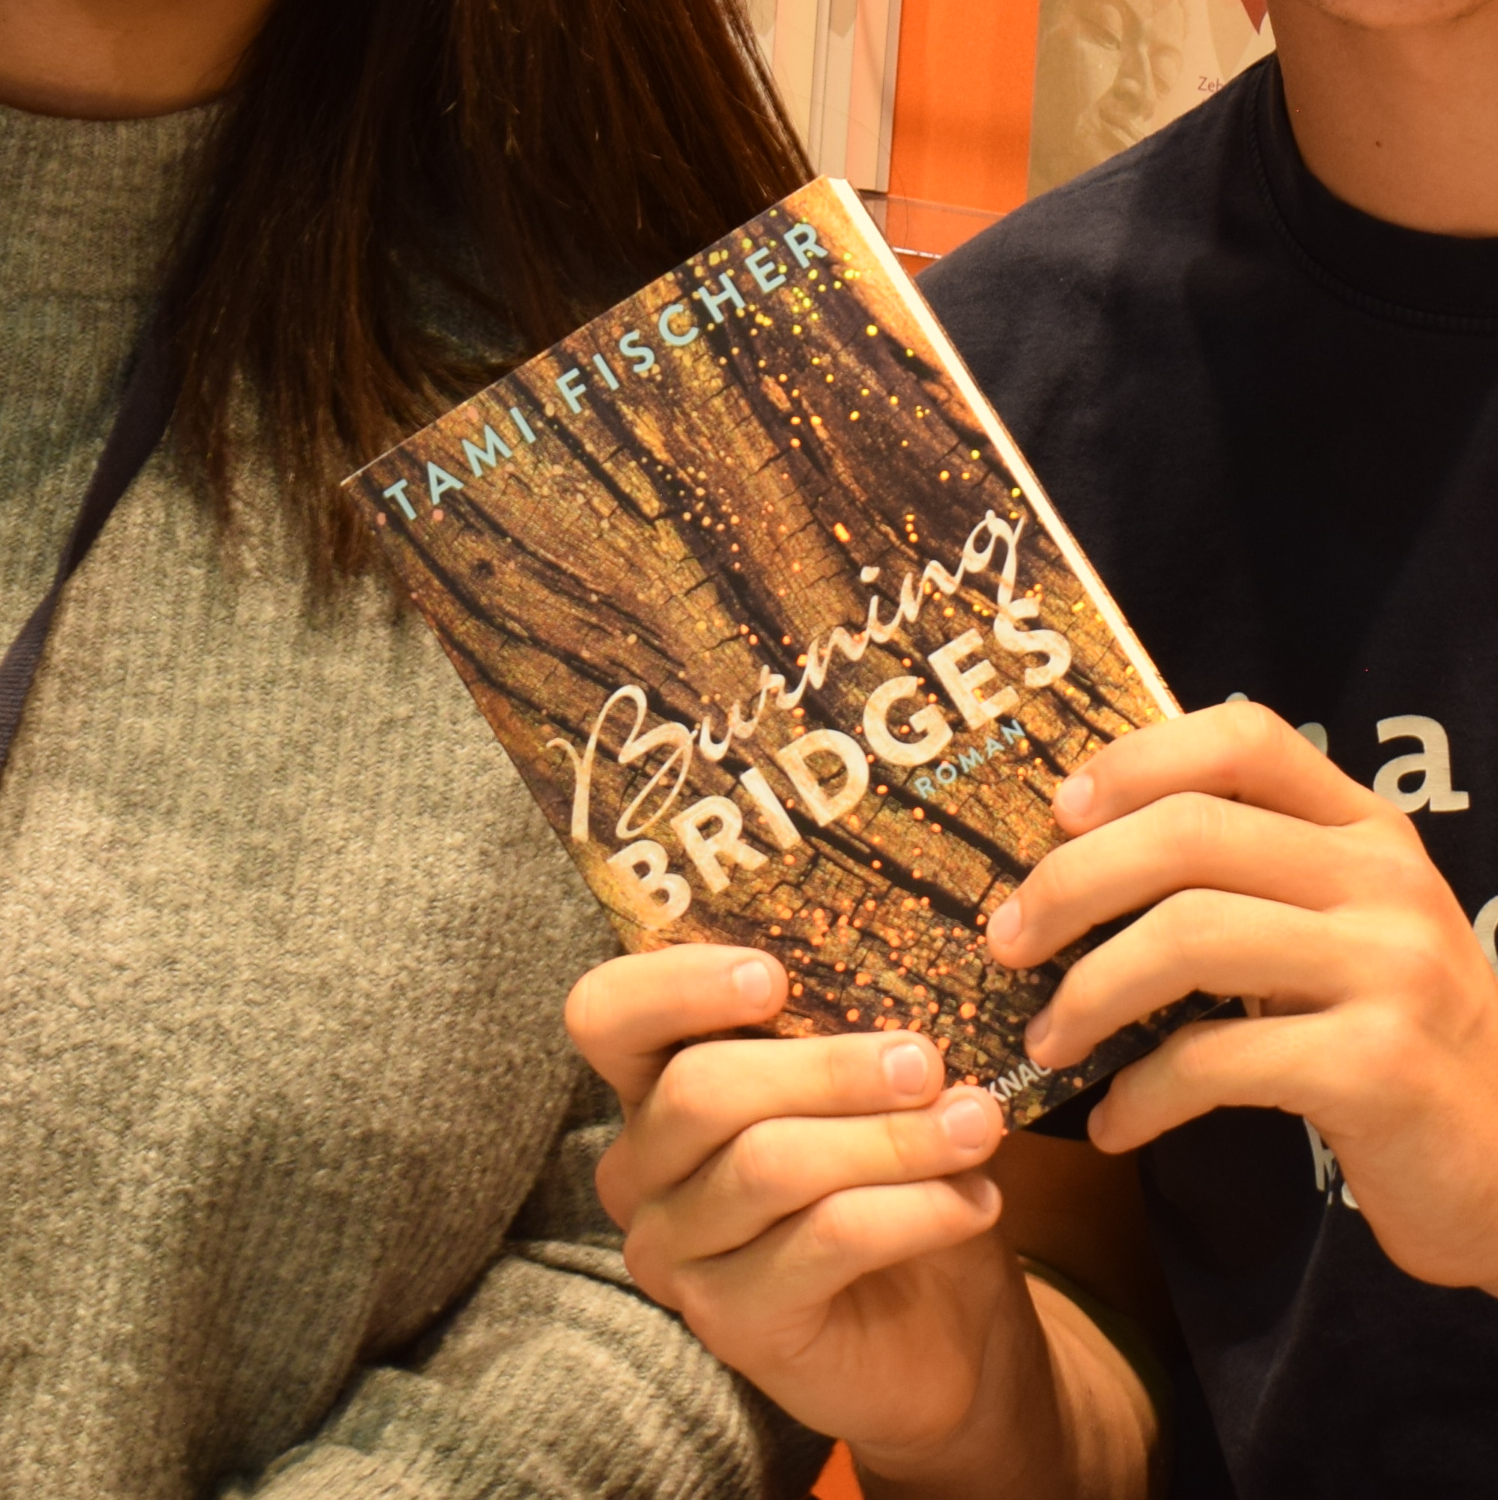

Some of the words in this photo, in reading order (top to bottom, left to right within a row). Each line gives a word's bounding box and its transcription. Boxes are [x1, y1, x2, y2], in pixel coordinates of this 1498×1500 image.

[383, 405, 537, 522] TAMI
[555, 221, 828, 416] FISCHER
[547, 509, 1025, 843] Burning
[606, 597, 1073, 930] BRIDGES
[915, 718, 1026, 799] ROMAN
[1373, 714, 1470, 815] a
